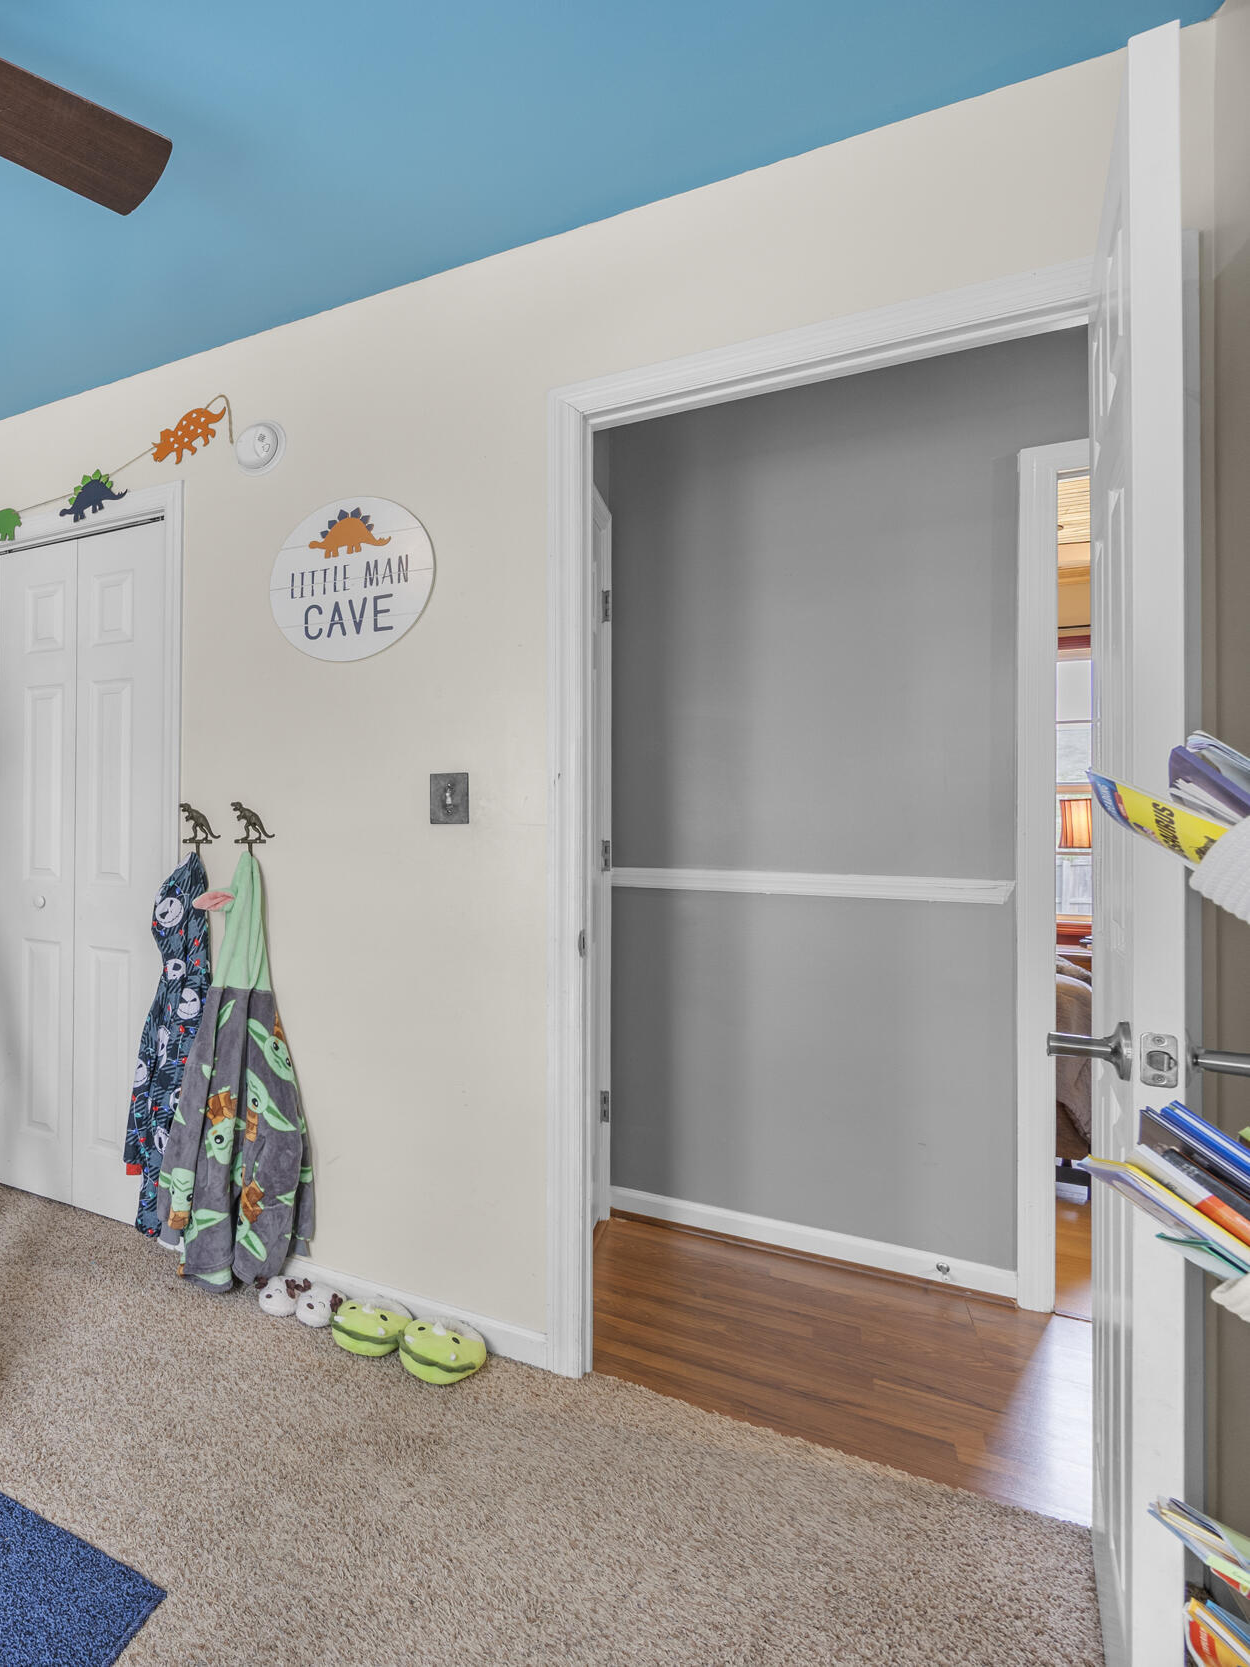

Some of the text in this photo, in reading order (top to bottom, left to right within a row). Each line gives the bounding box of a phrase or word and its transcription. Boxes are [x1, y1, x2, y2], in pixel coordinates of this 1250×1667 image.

[290, 554, 409, 599] LITTLE MAN
[304, 593, 394, 640] CAVE
